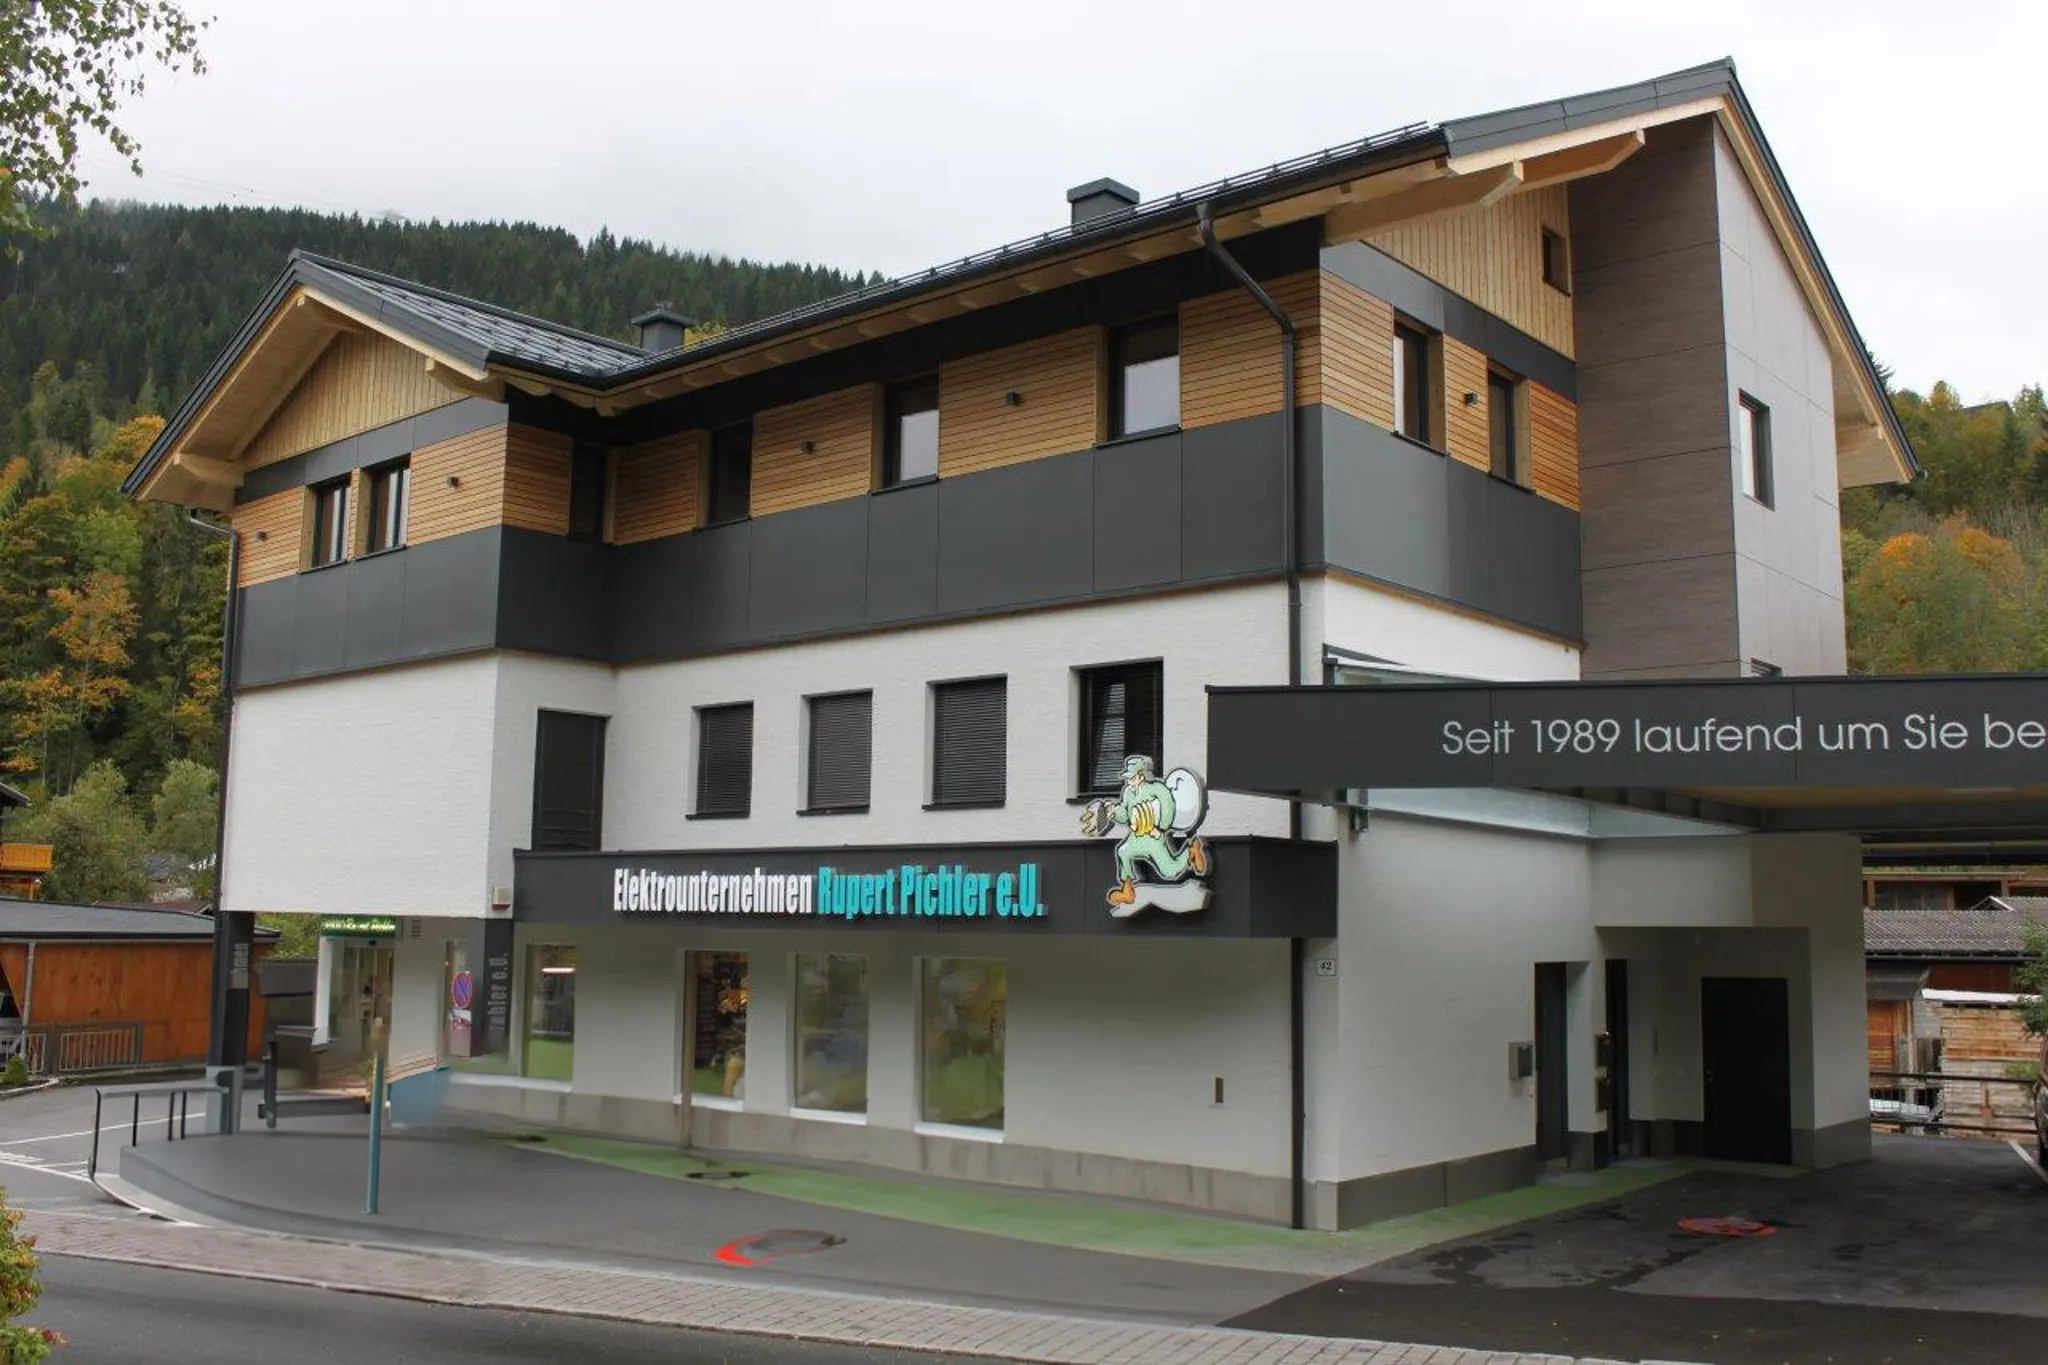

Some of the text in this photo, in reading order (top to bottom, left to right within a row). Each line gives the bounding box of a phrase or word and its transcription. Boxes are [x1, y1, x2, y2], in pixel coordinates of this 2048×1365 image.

[1441, 720, 1515, 755] Seit
[1531, 719, 1621, 753] 1989
[1635, 716, 1804, 753] laufend
[1818, 722, 1889, 751] um
[1903, 713, 1969, 750] Sie
[613, 862, 1044, 920] Elektrounternehmen Rupert Pichler e.U.
